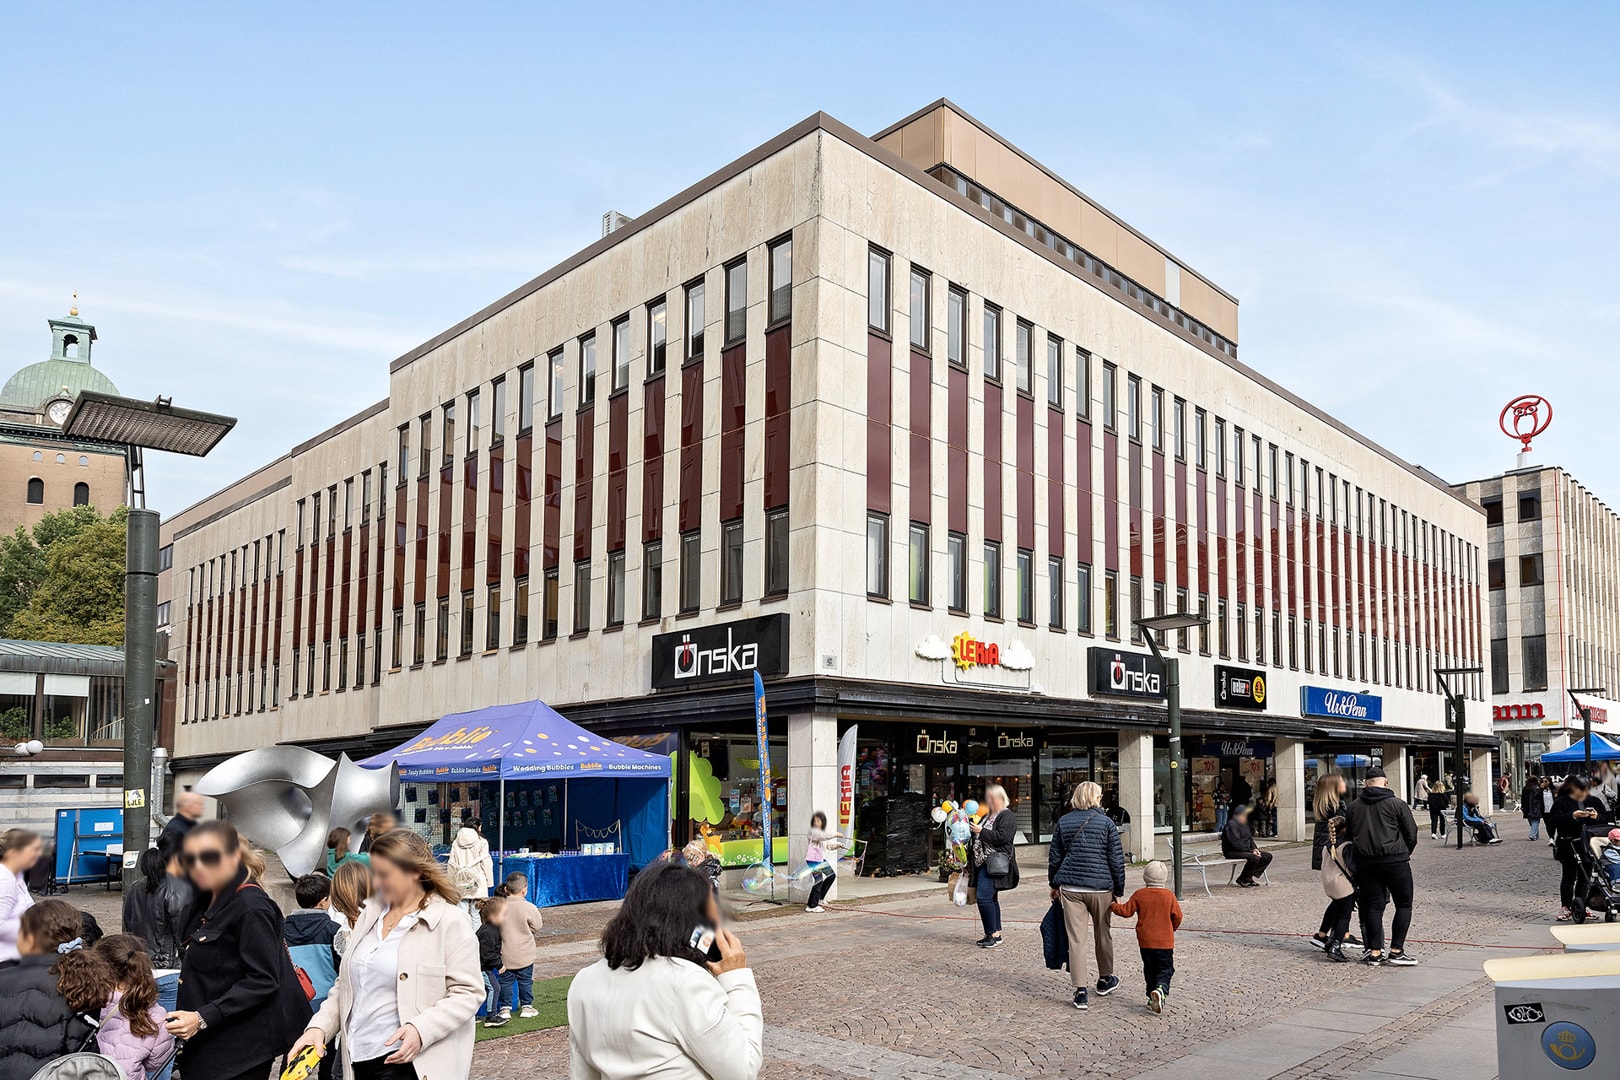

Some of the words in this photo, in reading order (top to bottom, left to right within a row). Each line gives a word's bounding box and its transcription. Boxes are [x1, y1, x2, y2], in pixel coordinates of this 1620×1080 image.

[674, 627, 758, 679] Önska
[1110, 653, 1160, 693] Önska
[1324, 691, 1367, 718] Ur&Penn
[916, 729, 958, 754] Önska
[997, 731, 1034, 749] Önska
